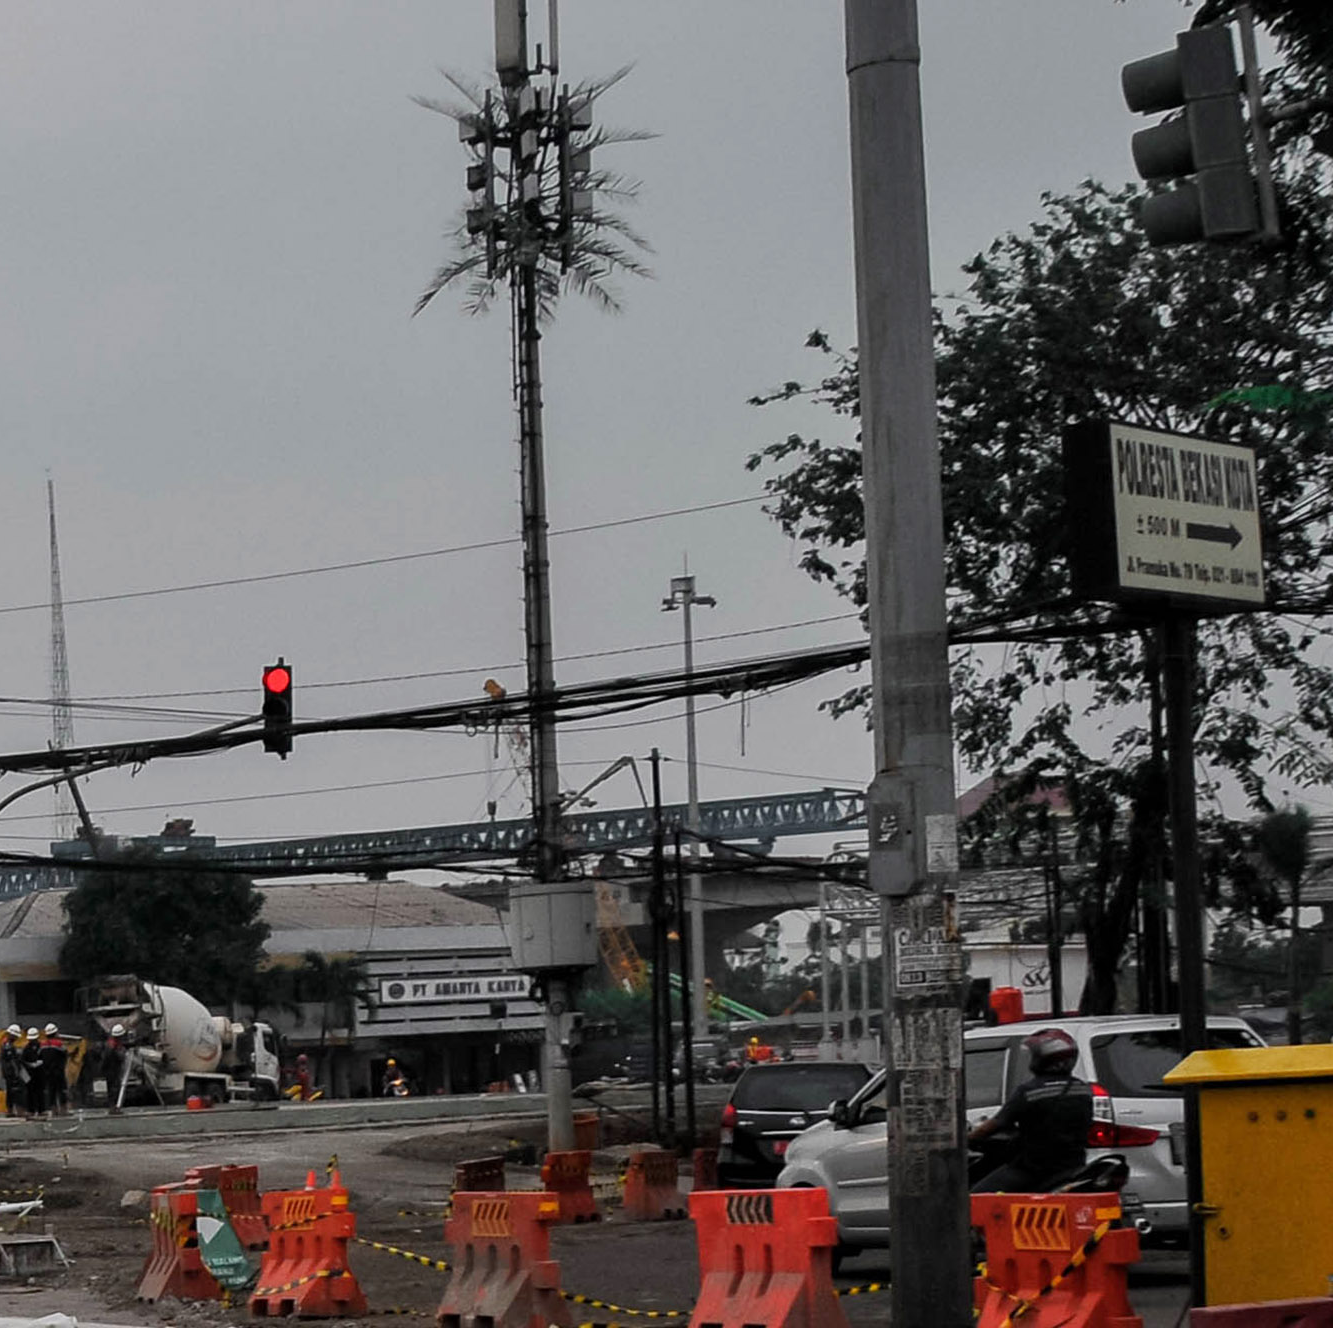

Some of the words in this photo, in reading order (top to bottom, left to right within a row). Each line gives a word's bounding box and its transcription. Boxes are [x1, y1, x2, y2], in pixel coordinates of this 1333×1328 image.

[1116, 438, 1180, 501] POLRESTA
[1180, 450, 1225, 506] BEKASI
[1223, 456, 1255, 512] KOTA
[1147, 515, 1167, 537] 500
[1170, 517, 1181, 537] M
[412, 983, 427, 998] PT
